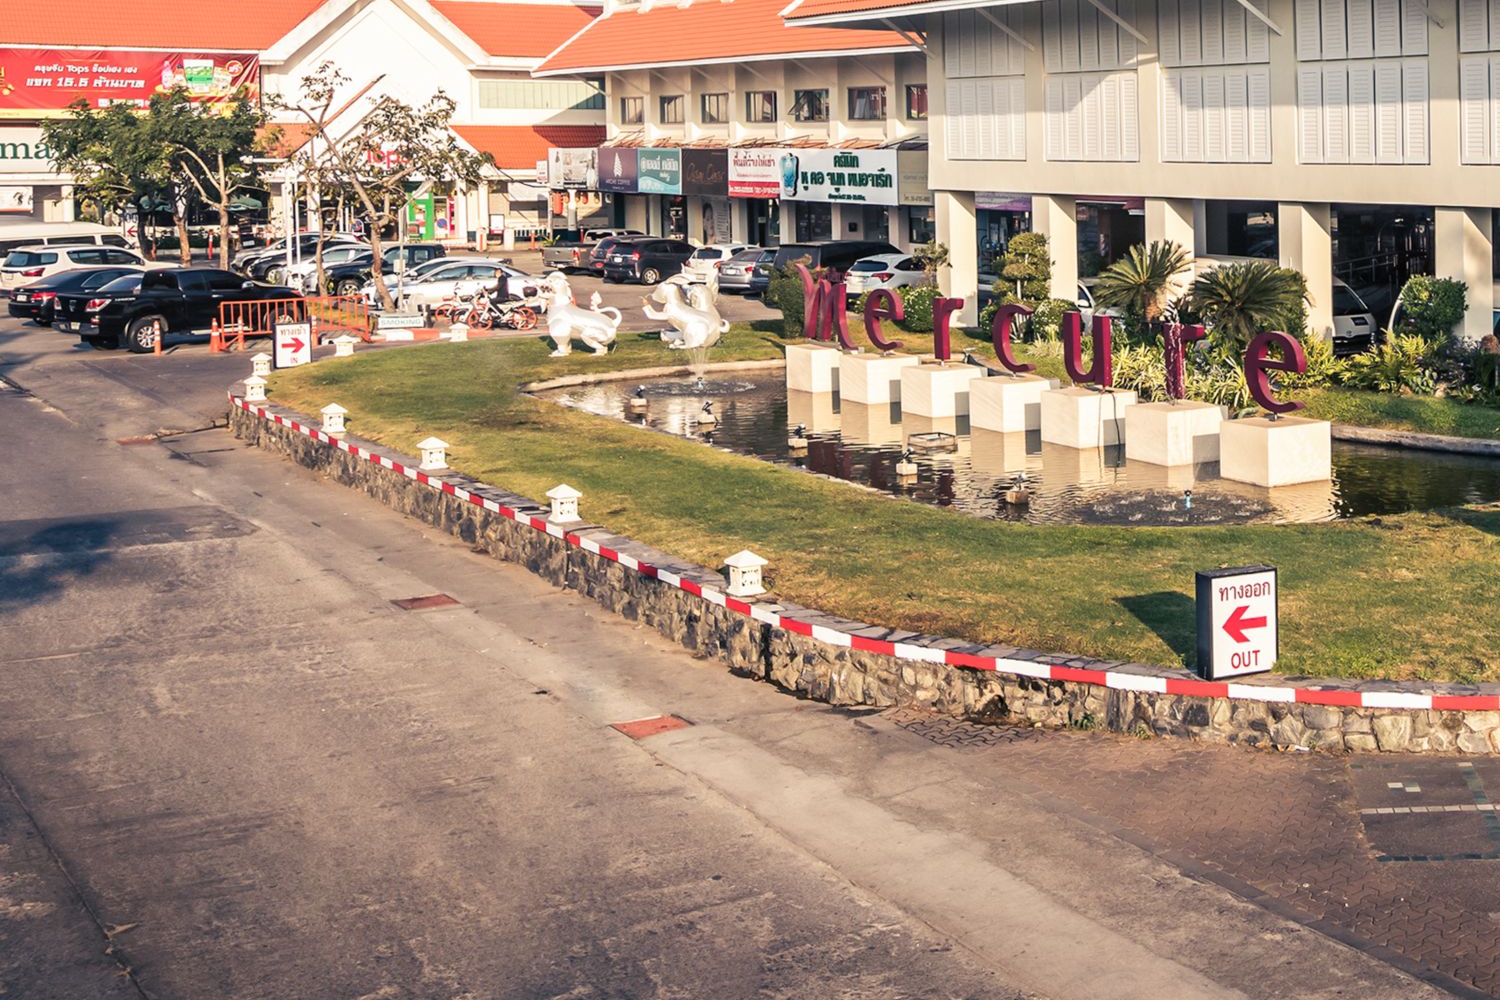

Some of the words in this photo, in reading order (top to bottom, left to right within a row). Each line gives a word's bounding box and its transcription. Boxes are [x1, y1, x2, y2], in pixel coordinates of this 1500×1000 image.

[66, 65, 89, 75] Tops
[56, 77, 89, 88] 15.5
[794, 262, 1308, 414] Mercure
[1218, 581, 1271, 602] ทางออก
[1231, 649, 1261, 669] OUT
